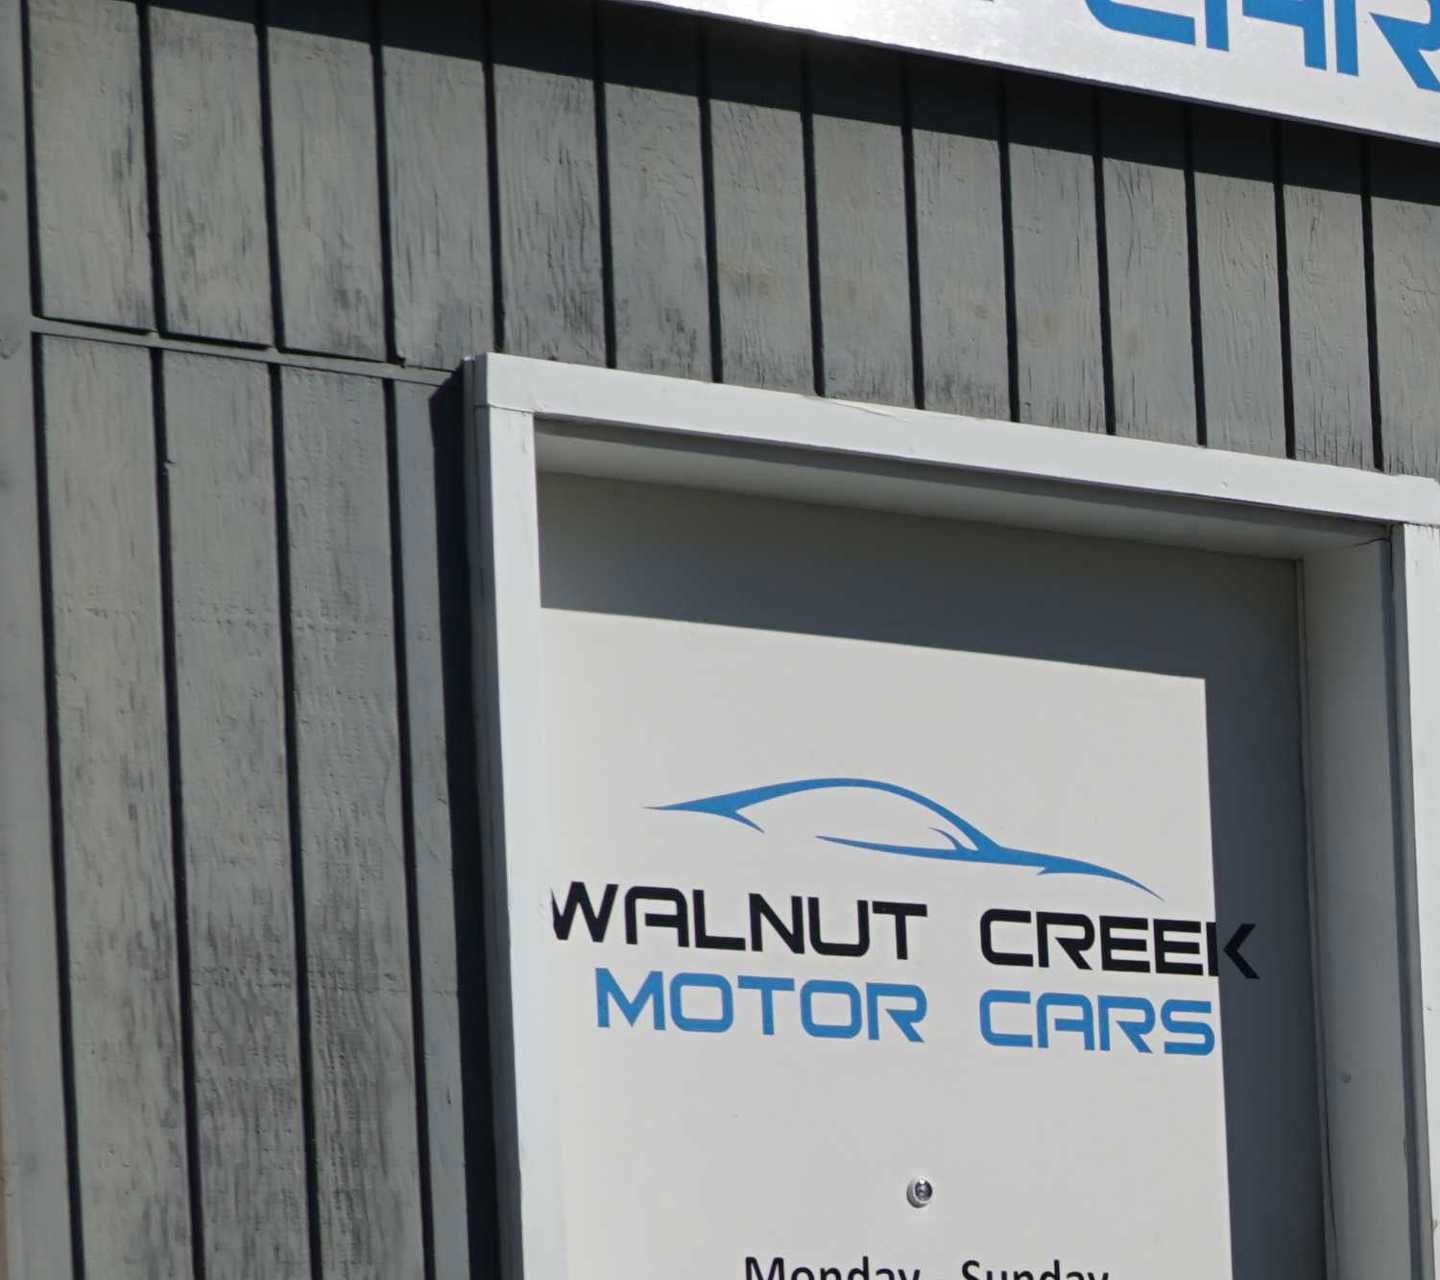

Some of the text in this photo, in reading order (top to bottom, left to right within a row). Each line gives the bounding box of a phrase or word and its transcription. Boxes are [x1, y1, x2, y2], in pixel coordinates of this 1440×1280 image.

[550, 880, 1261, 980] WALNUT CREEK
[595, 967, 1215, 1057] MOTOR CARS
